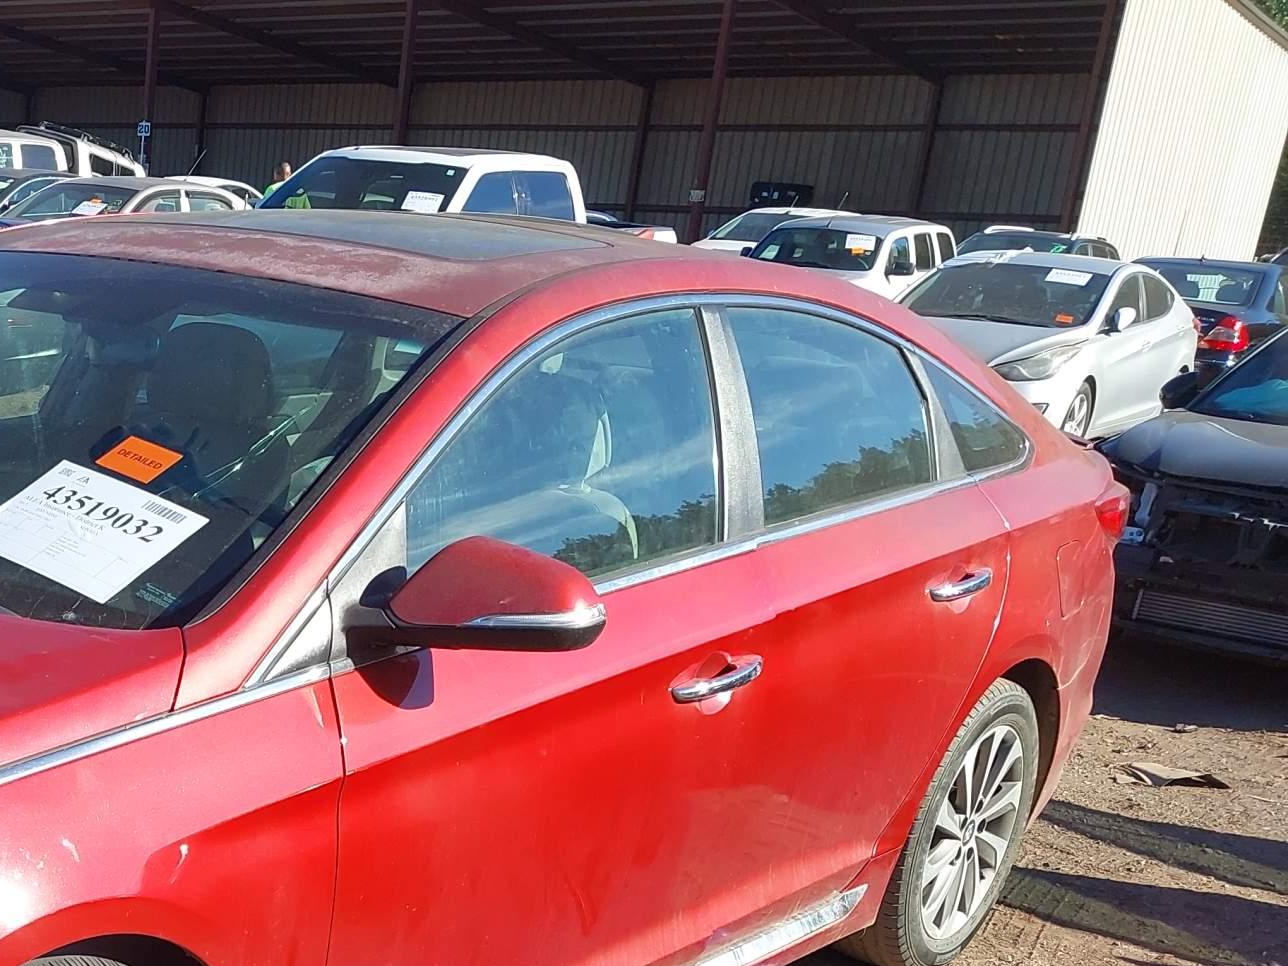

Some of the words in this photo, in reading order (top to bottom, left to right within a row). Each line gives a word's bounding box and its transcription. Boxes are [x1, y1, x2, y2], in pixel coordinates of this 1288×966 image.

[139, 125, 149, 133] 20
[117, 449, 162, 469] DETAILED
[43, 486, 163, 542] 43519032
